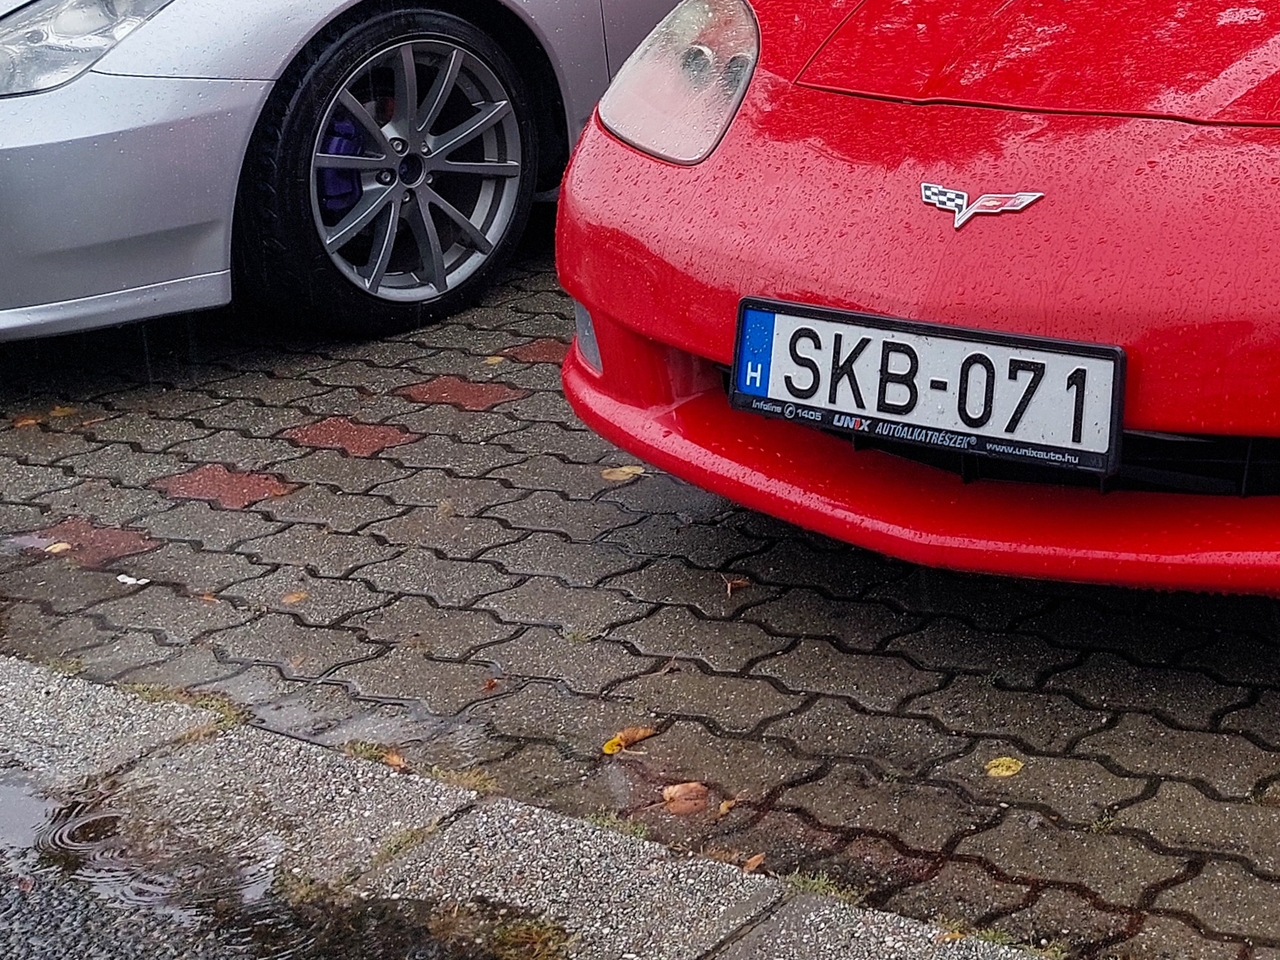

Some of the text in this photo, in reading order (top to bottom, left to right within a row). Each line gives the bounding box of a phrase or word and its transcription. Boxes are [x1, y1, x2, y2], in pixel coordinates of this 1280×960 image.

[746, 361, 762, 387] H
[783, 326, 1087, 444] SKB-071
[752, 400, 823, 422] Infoline 1405
[986, 442, 1080, 464] www.unixauto.hu
